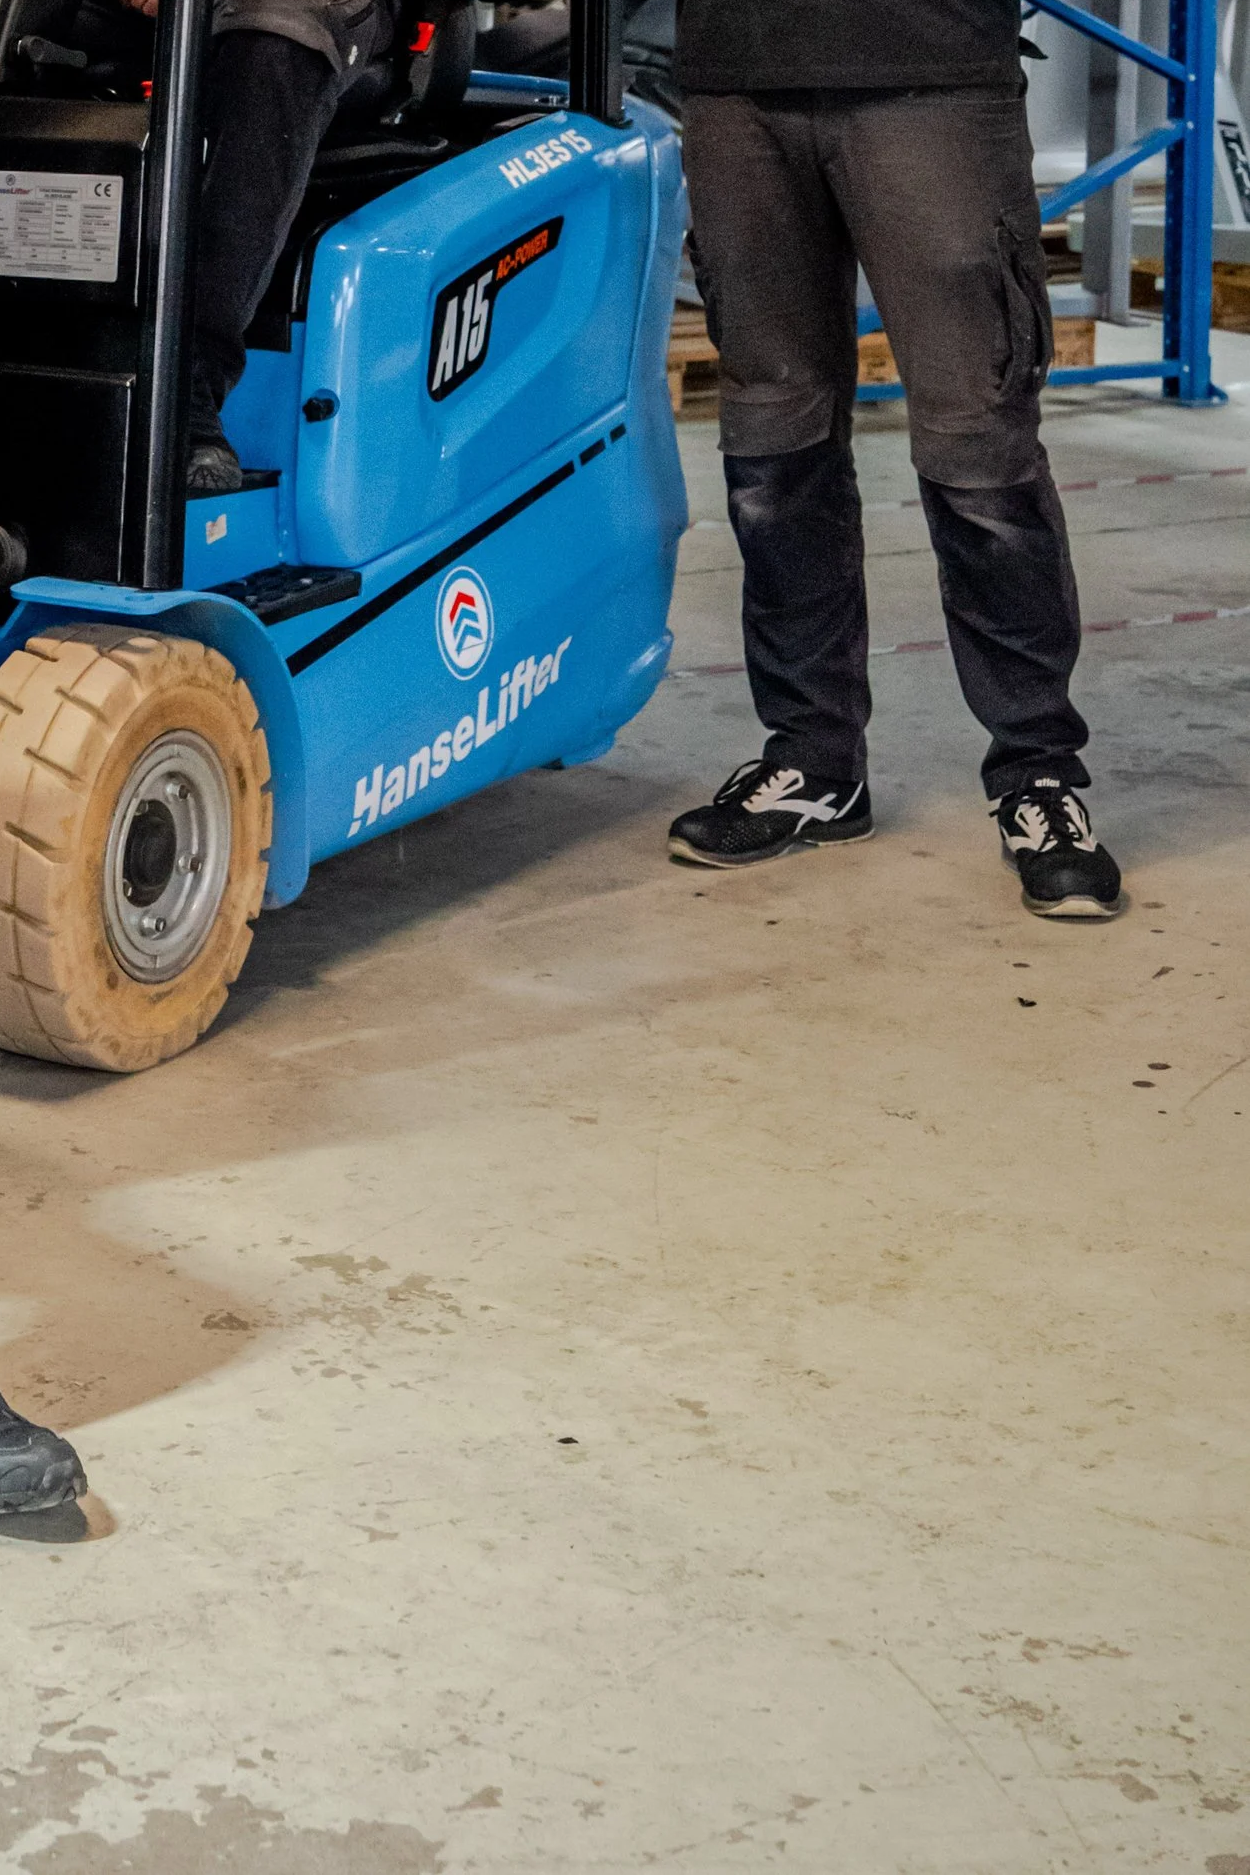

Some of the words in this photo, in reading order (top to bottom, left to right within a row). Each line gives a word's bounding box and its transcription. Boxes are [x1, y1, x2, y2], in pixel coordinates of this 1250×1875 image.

[495, 229, 550, 282] AC-POWER
[431, 268, 495, 392] A15
[346, 635, 574, 840] HanseLifter
